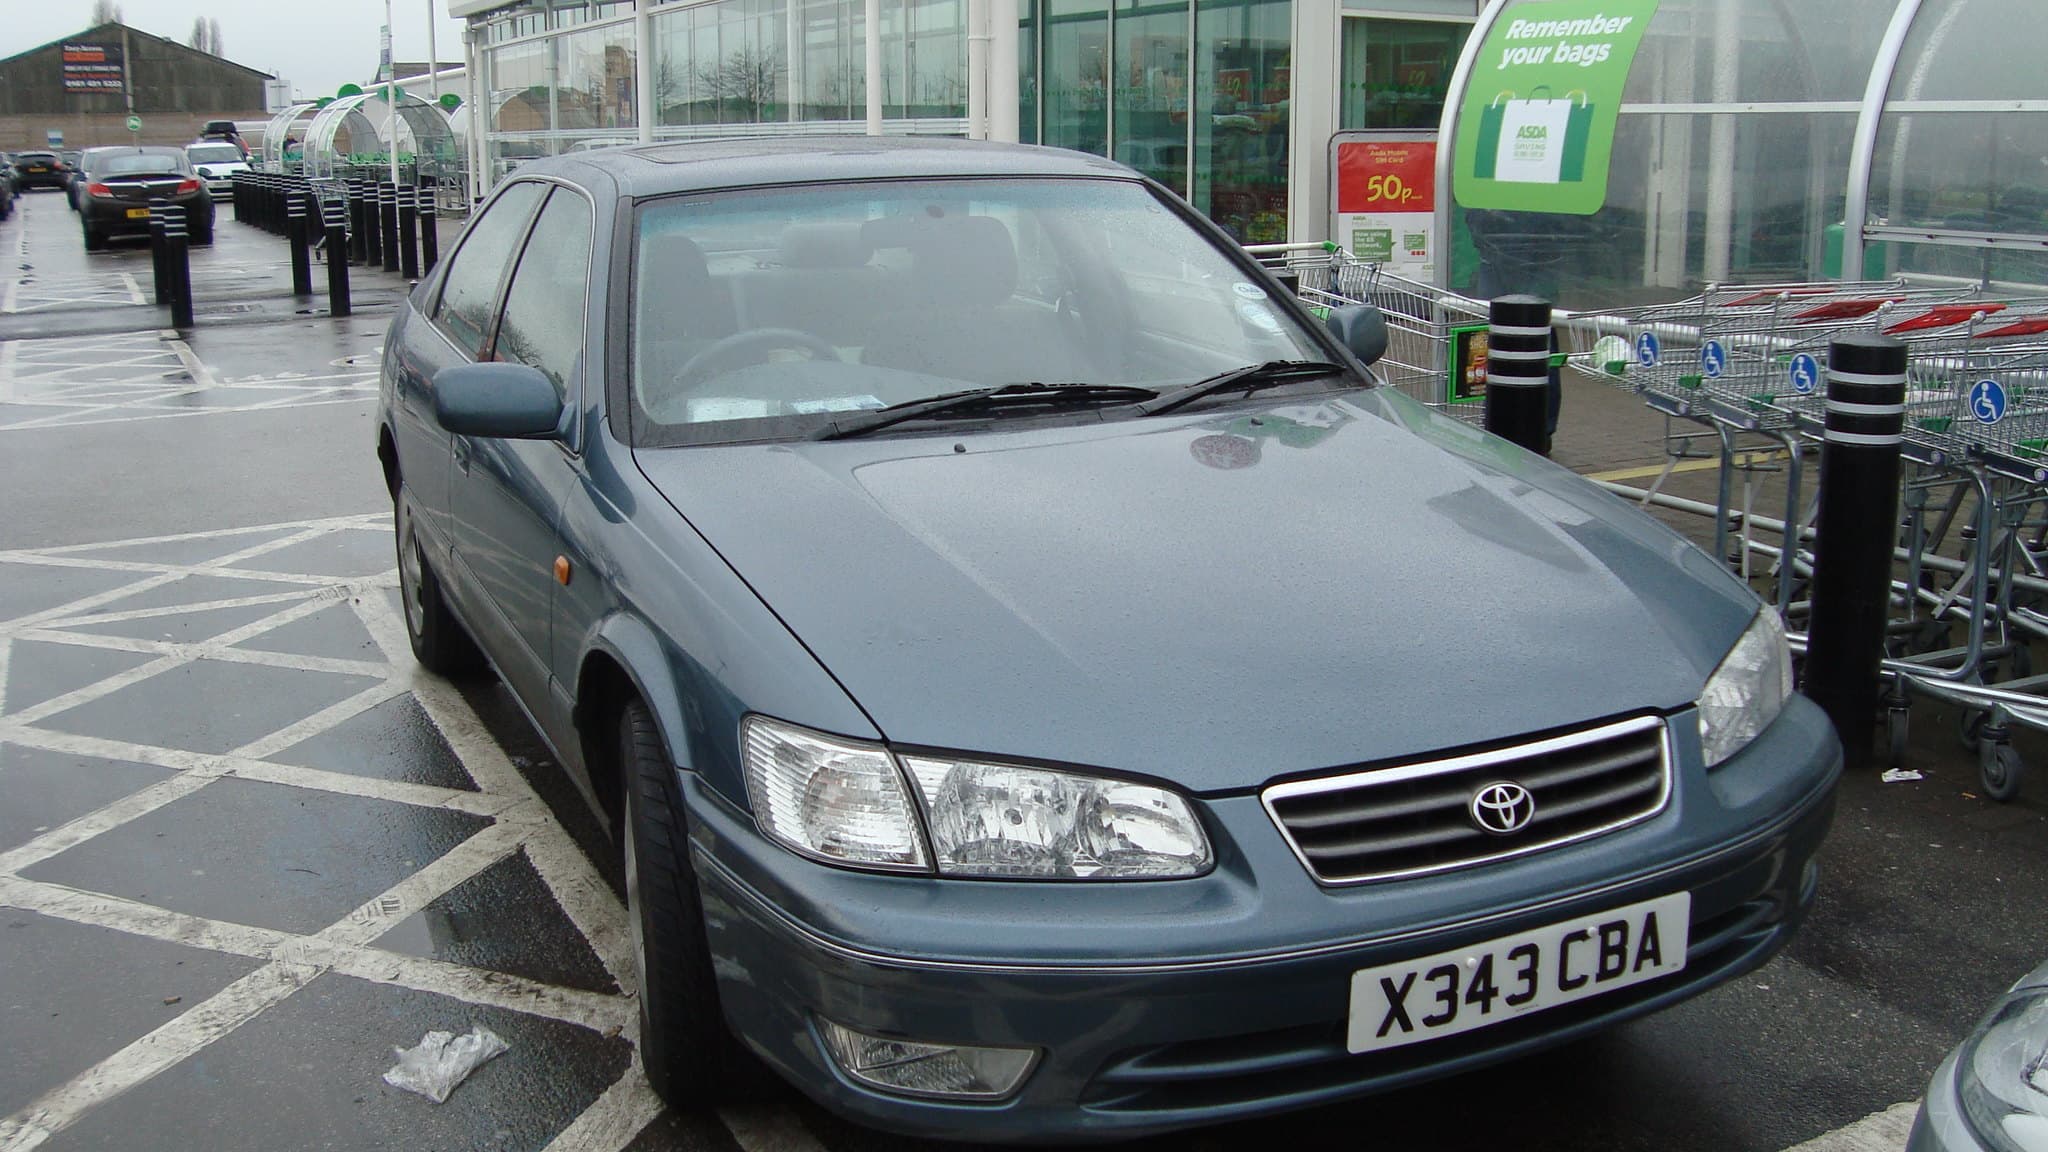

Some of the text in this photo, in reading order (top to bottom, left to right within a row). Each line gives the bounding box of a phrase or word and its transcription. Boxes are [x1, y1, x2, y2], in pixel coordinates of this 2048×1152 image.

[1506, 13, 1632, 39] Remember
[1497, 40, 1612, 70] your bags
[1516, 125, 1547, 139] ASDA
[1367, 174, 1412, 204] 50p
[1376, 911, 1662, 1038] X343 CBA
